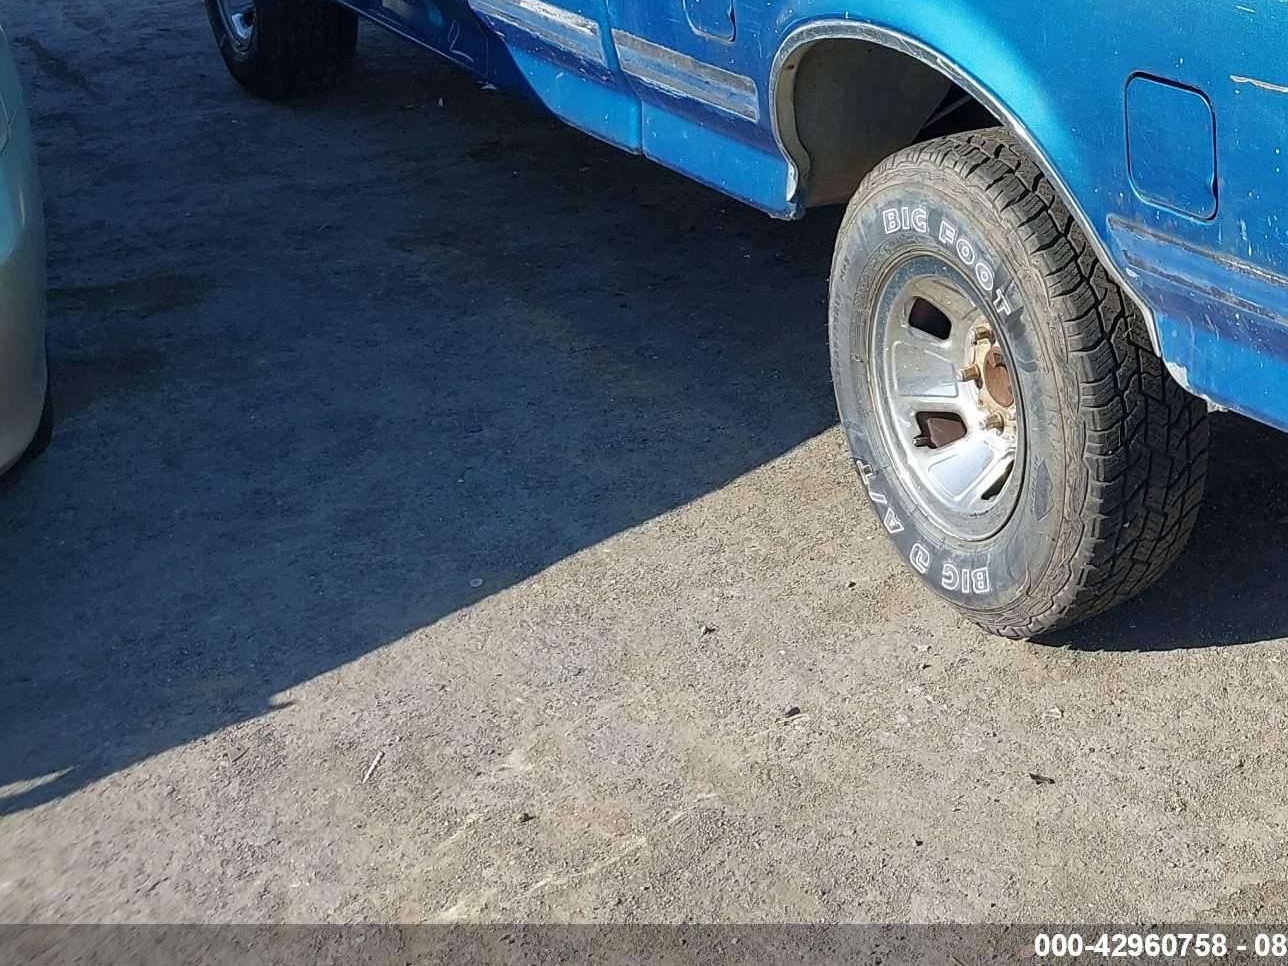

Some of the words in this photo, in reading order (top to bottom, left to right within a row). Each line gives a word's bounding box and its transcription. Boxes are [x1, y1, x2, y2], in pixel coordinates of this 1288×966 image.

[882, 206, 929, 234] BIG
[938, 220, 1012, 315] FOOT
[856, 459, 905, 534] A/T
[941, 563, 991, 594] BIG
